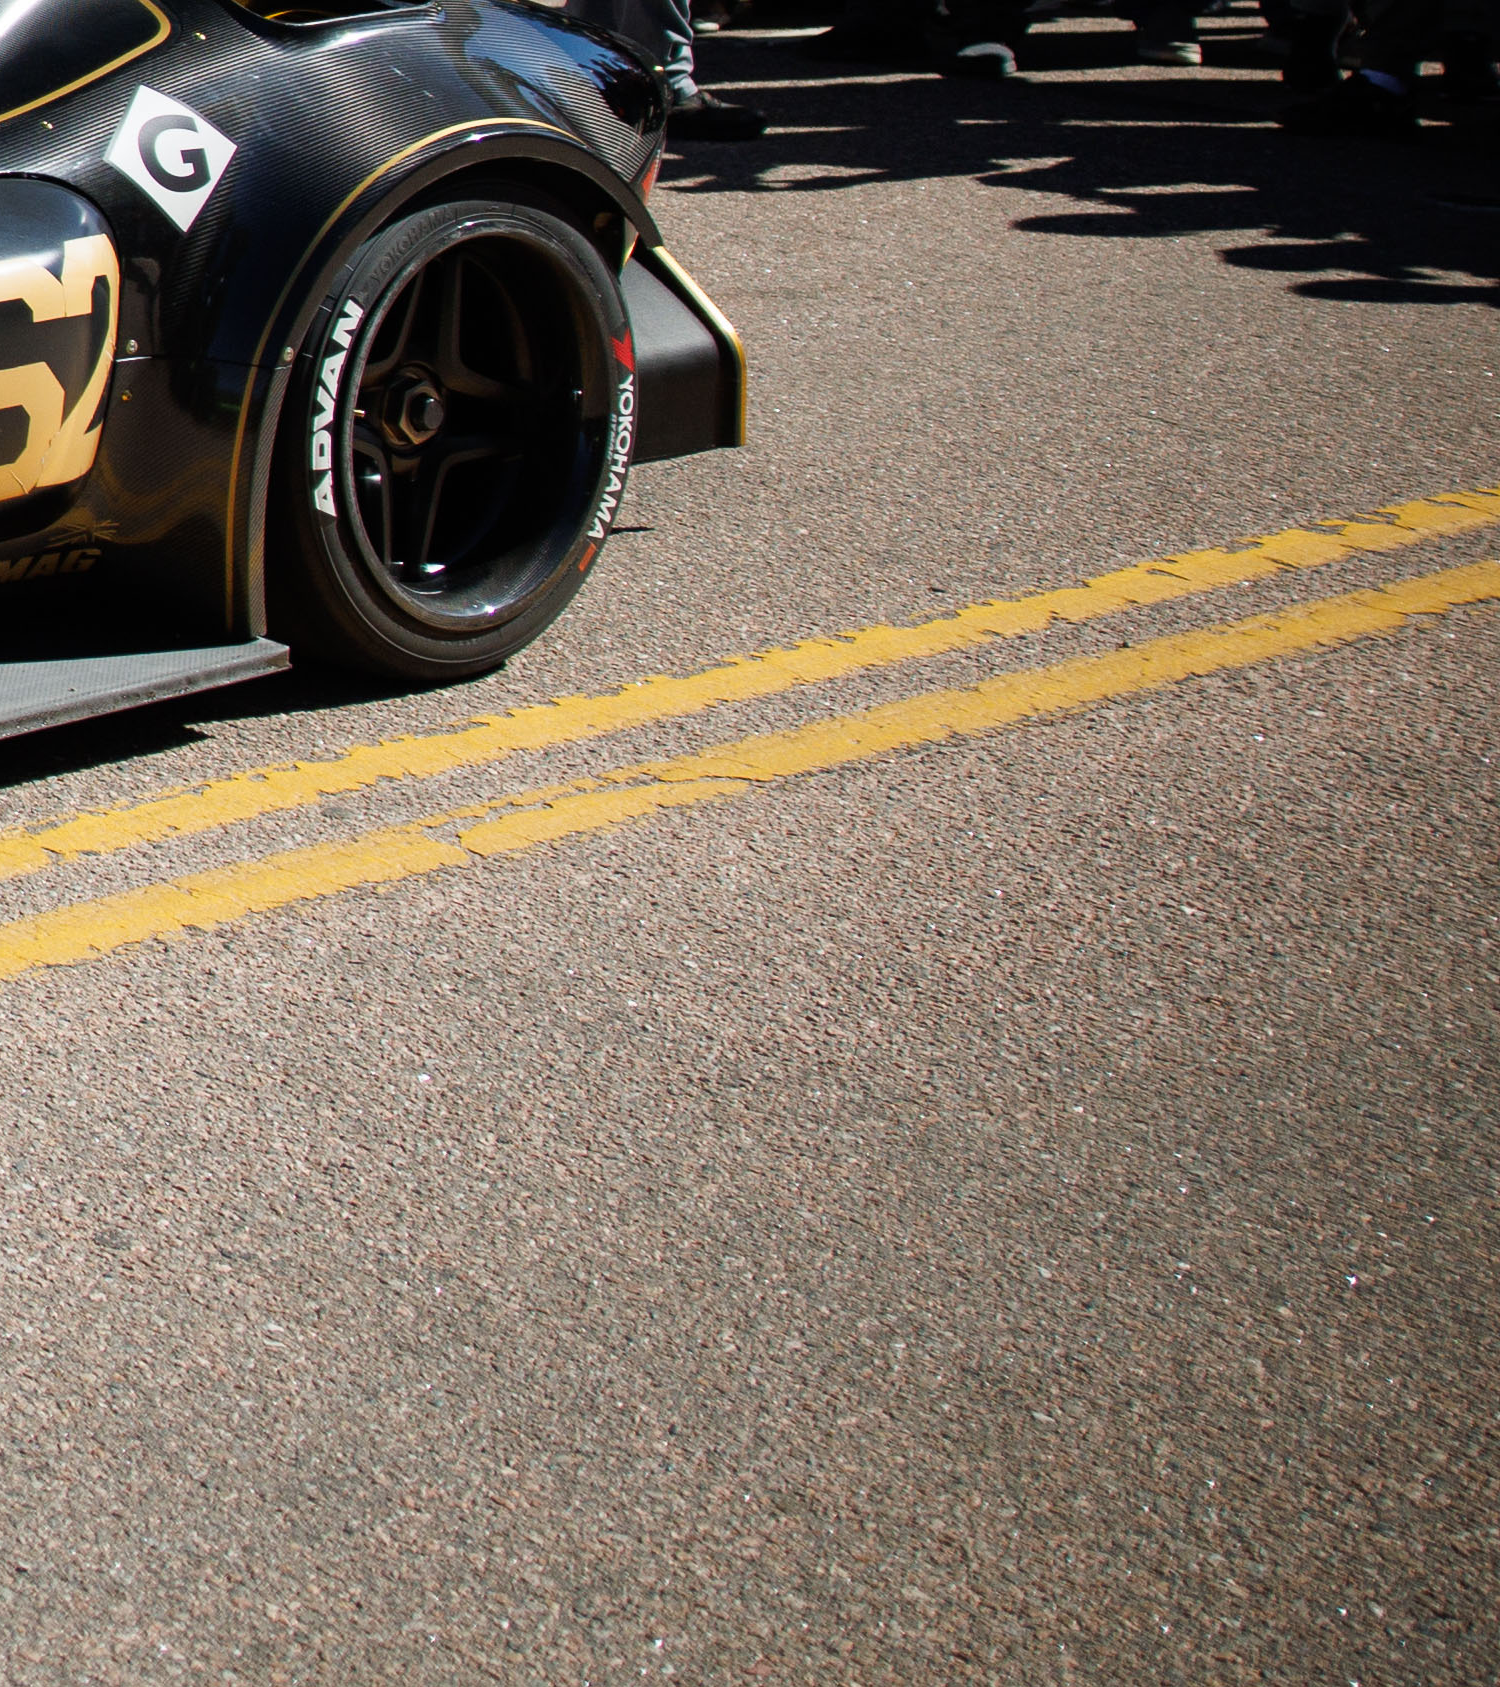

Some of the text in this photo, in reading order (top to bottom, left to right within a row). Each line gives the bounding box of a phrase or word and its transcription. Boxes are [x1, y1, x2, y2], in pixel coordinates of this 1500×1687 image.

[136, 114, 212, 193] G
[312, 299, 365, 518] ADVAN
[588, 373, 635, 540] YOKOHAMA
